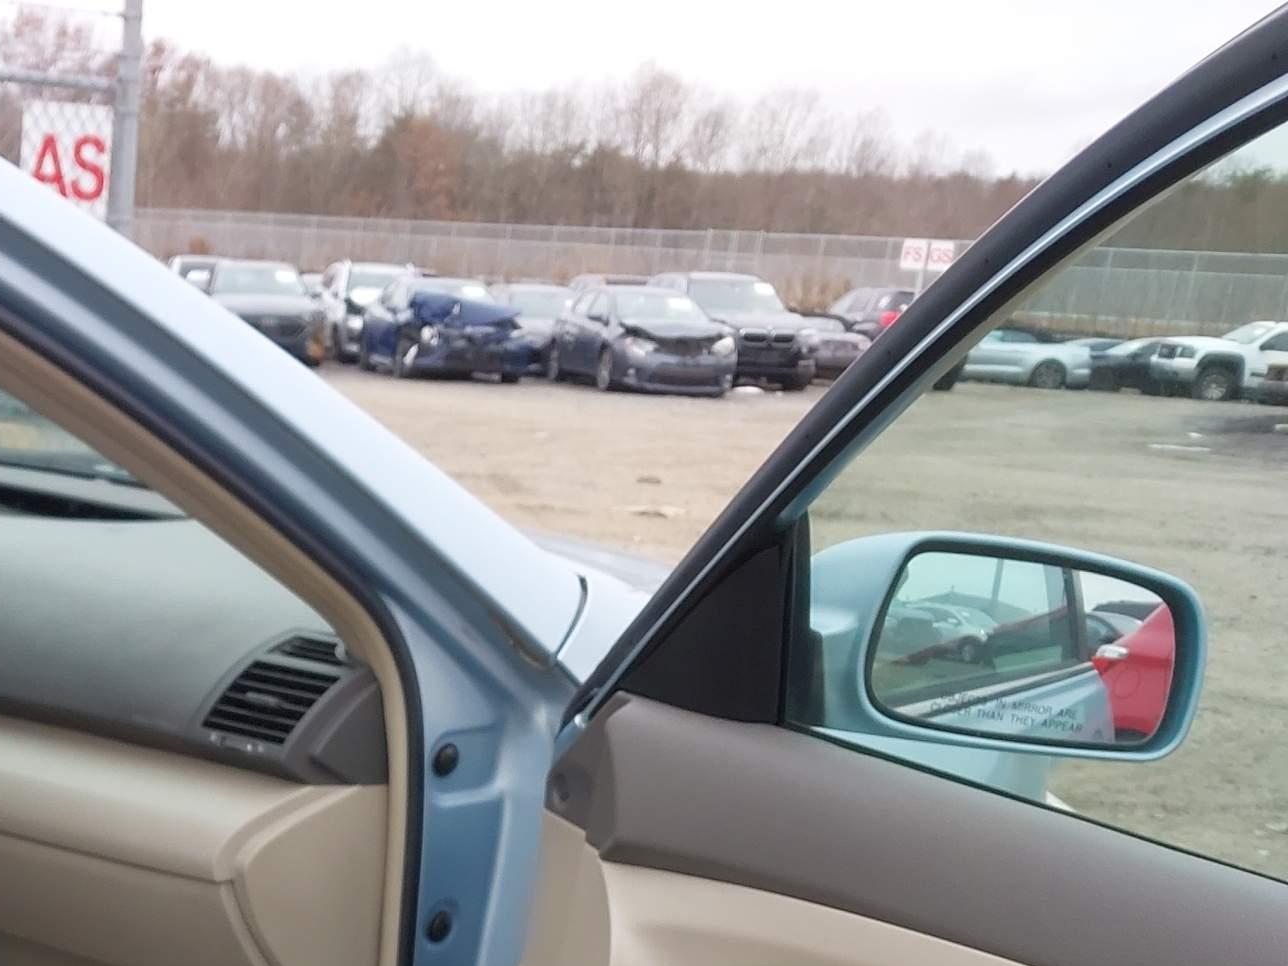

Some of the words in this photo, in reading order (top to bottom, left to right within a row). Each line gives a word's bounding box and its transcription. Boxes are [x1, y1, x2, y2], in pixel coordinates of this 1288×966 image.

[33, 133, 105, 201] AS
[976, 708, 1004, 721] THAN
[1011, 713, 1034, 728] THEY
[1039, 717, 1083, 732] APPEAR
[1012, 701, 1053, 715] MIRROR
[1057, 708, 1078, 720] ARE
